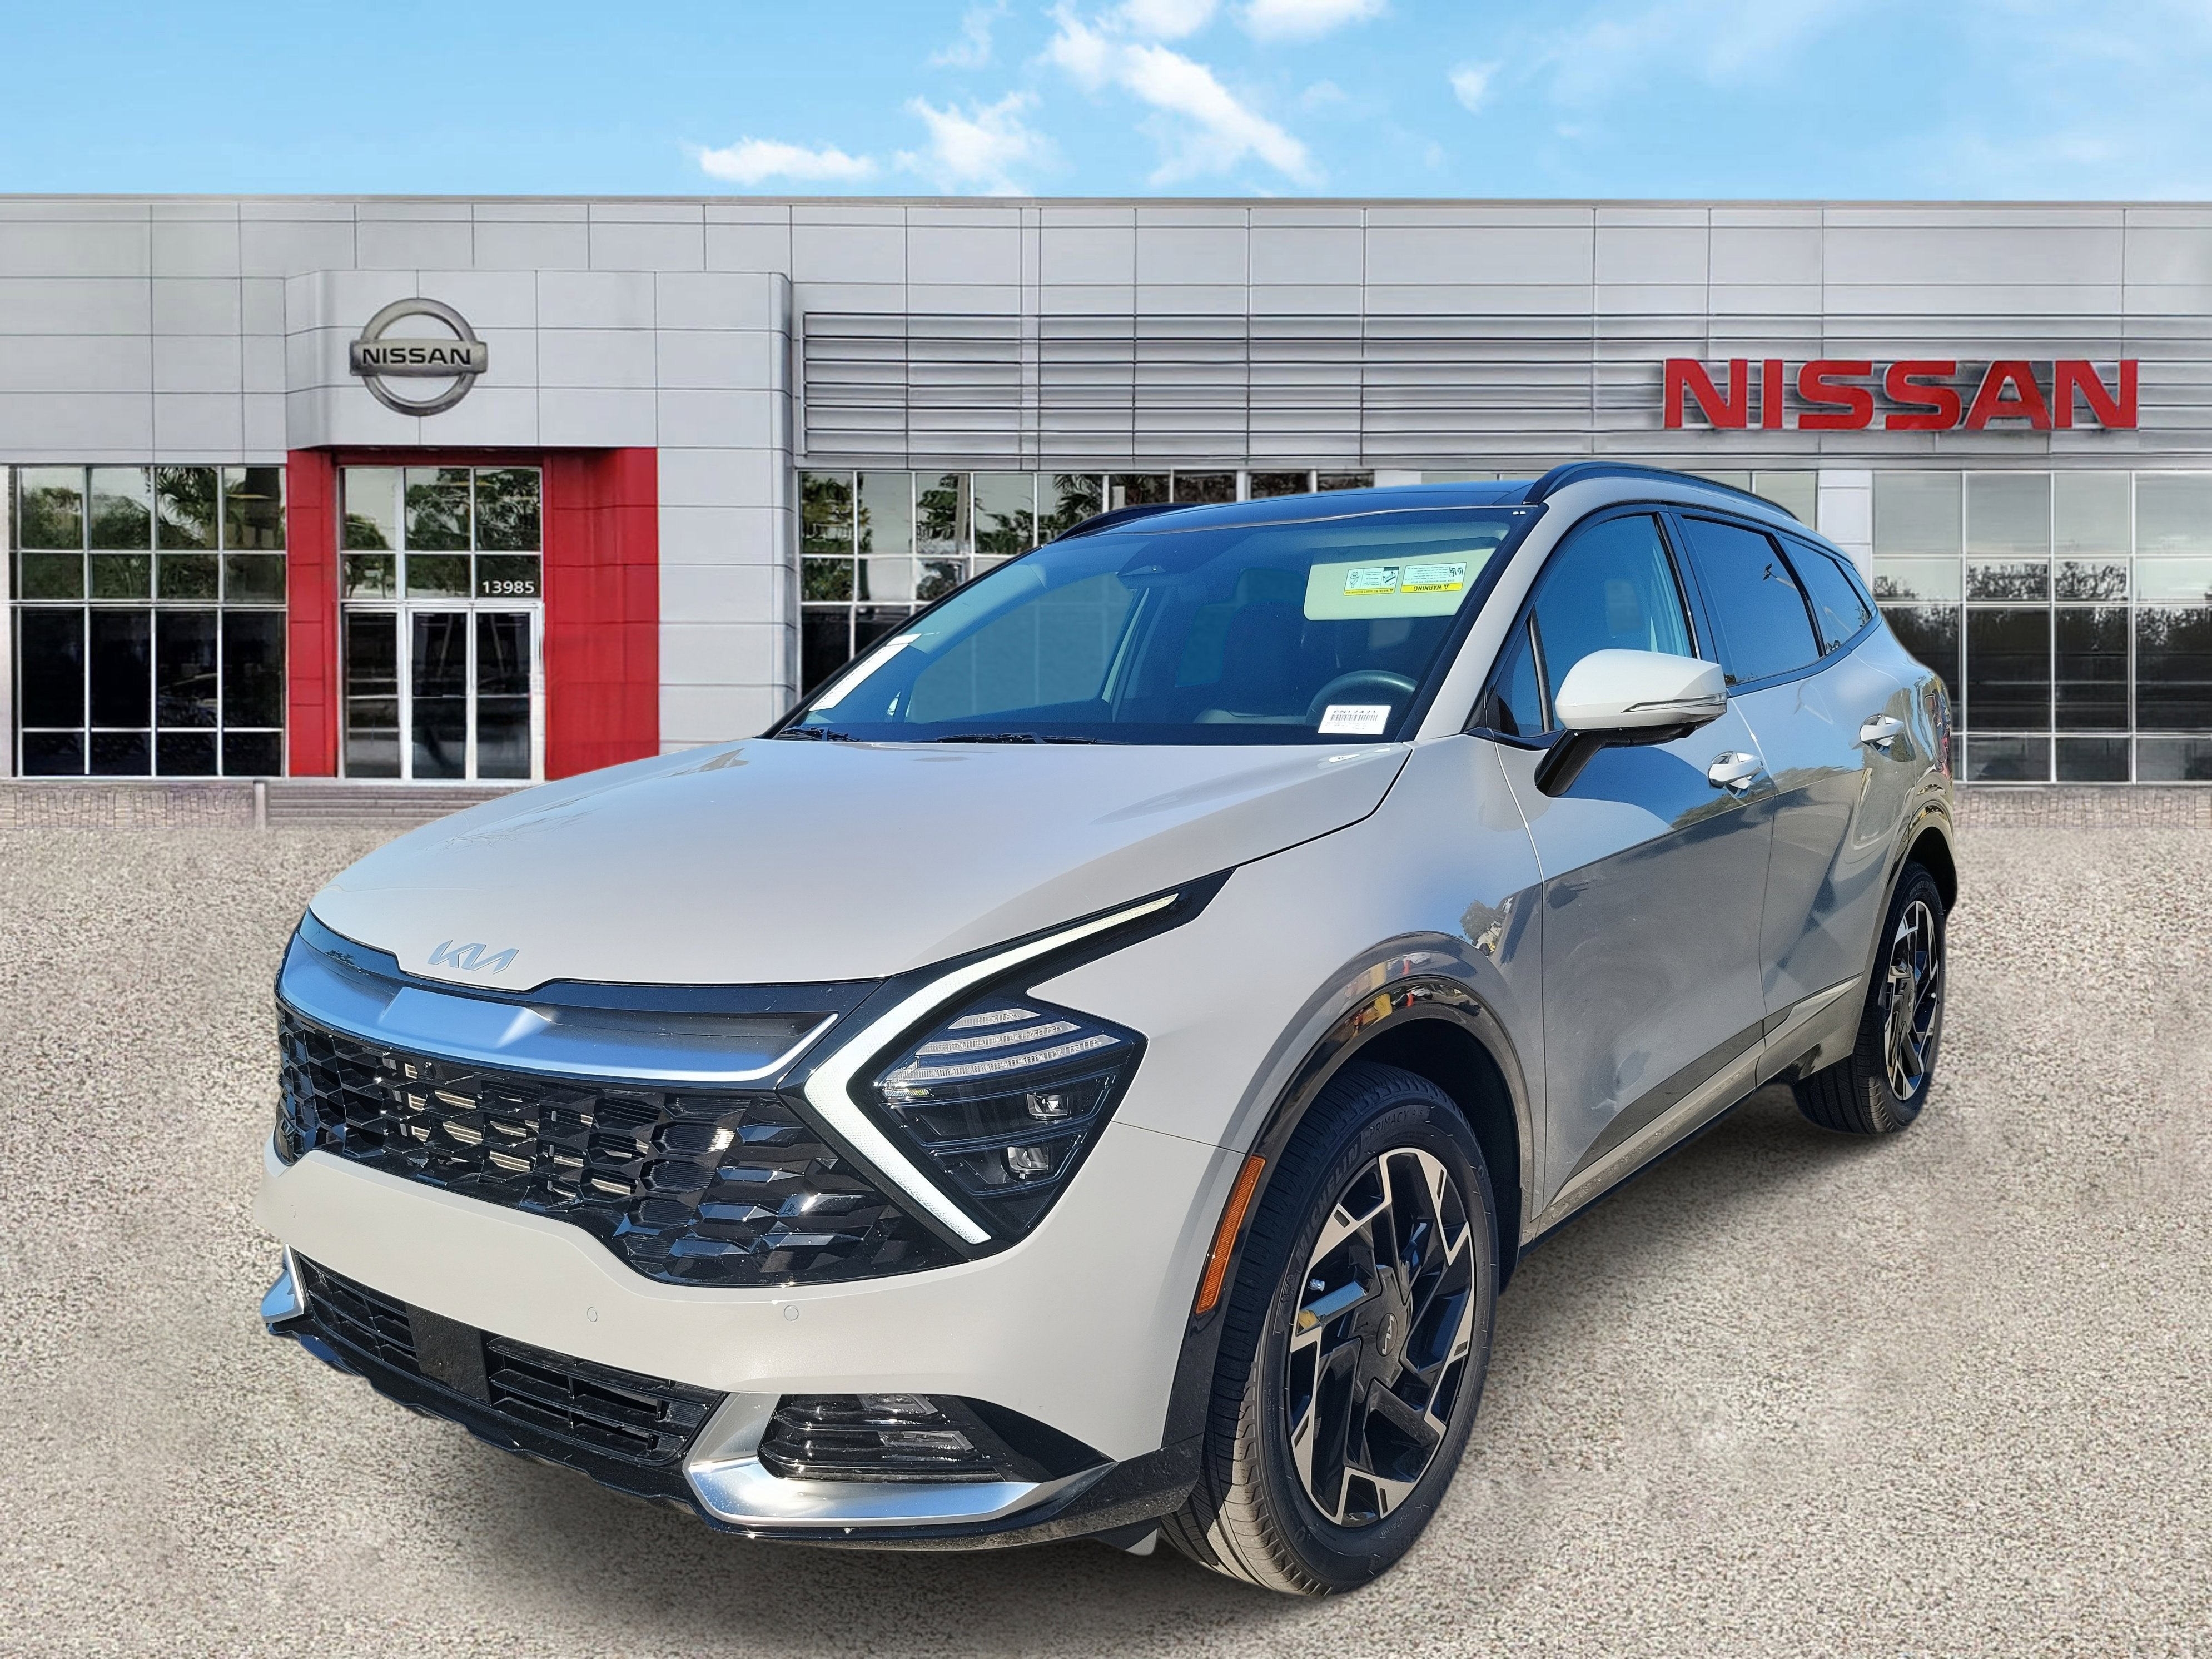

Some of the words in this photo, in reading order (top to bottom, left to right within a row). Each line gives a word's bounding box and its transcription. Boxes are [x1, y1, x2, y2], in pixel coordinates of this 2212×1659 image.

[362, 347, 471, 365] NISSAN
[1663, 358, 2139, 430] NISSAN
[482, 580, 535, 594] 13985
